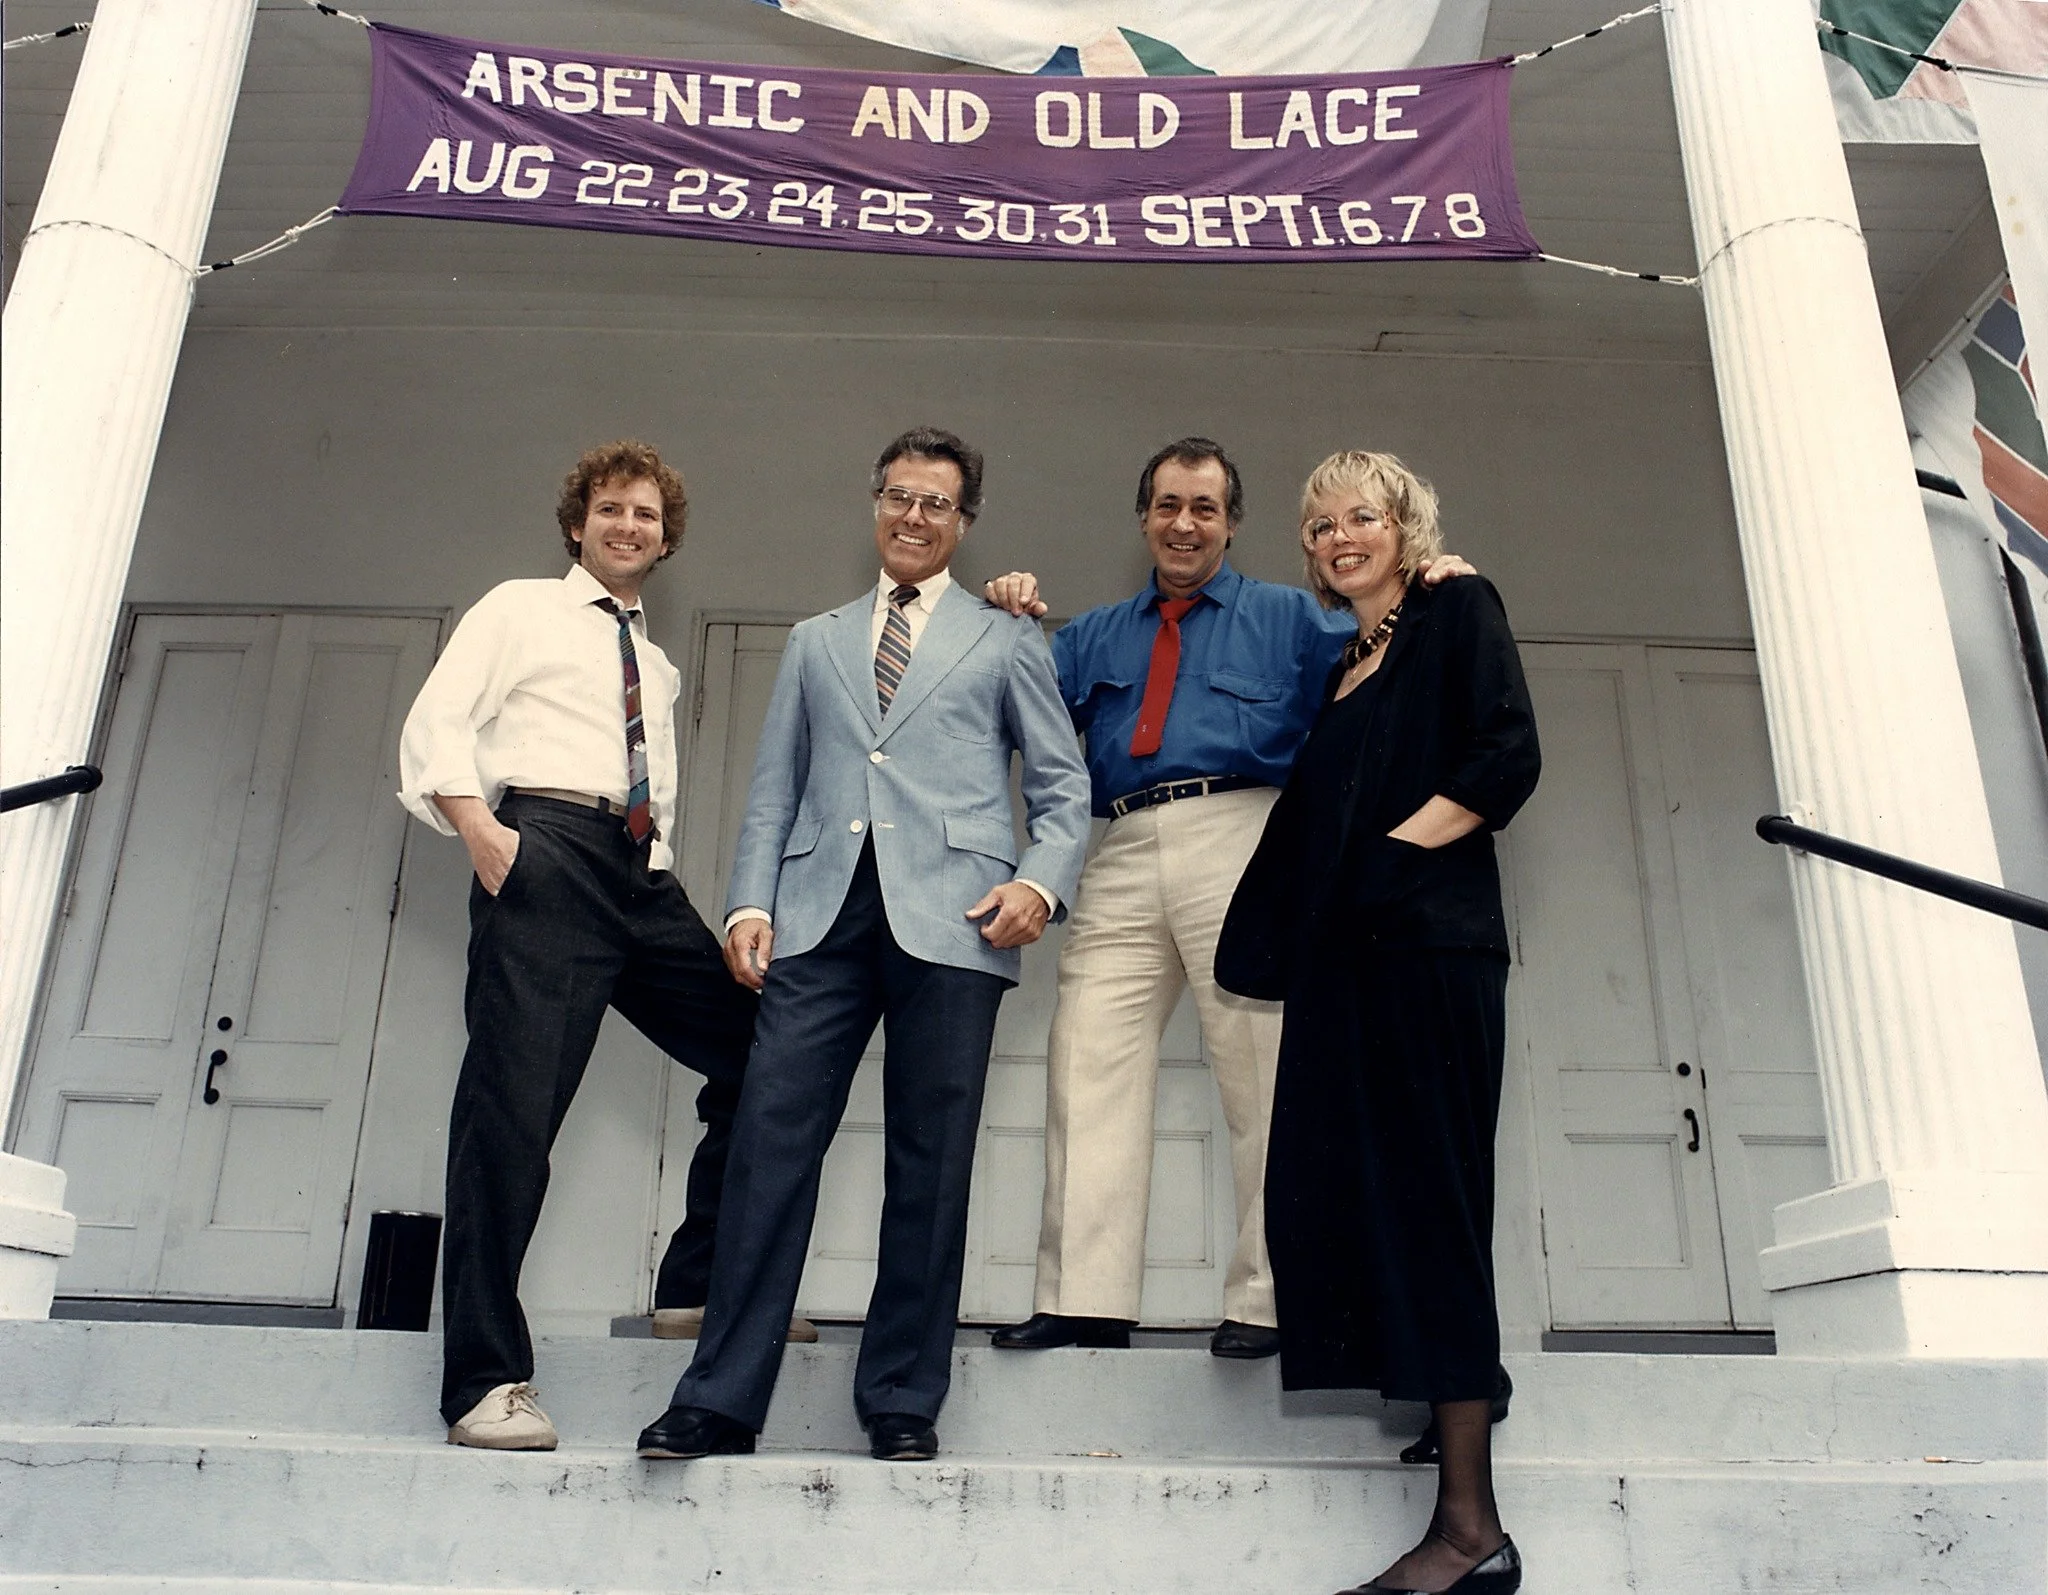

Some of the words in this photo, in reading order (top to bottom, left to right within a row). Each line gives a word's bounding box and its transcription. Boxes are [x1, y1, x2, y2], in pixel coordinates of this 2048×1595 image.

[461, 52, 805, 133] ARSENIC
[850, 85, 991, 144] AND
[1034, 90, 1181, 149] OLD
[1228, 84, 1421, 150] LACE
[405, 137, 555, 201] AUG
[1140, 193, 1303, 248] SEPT
